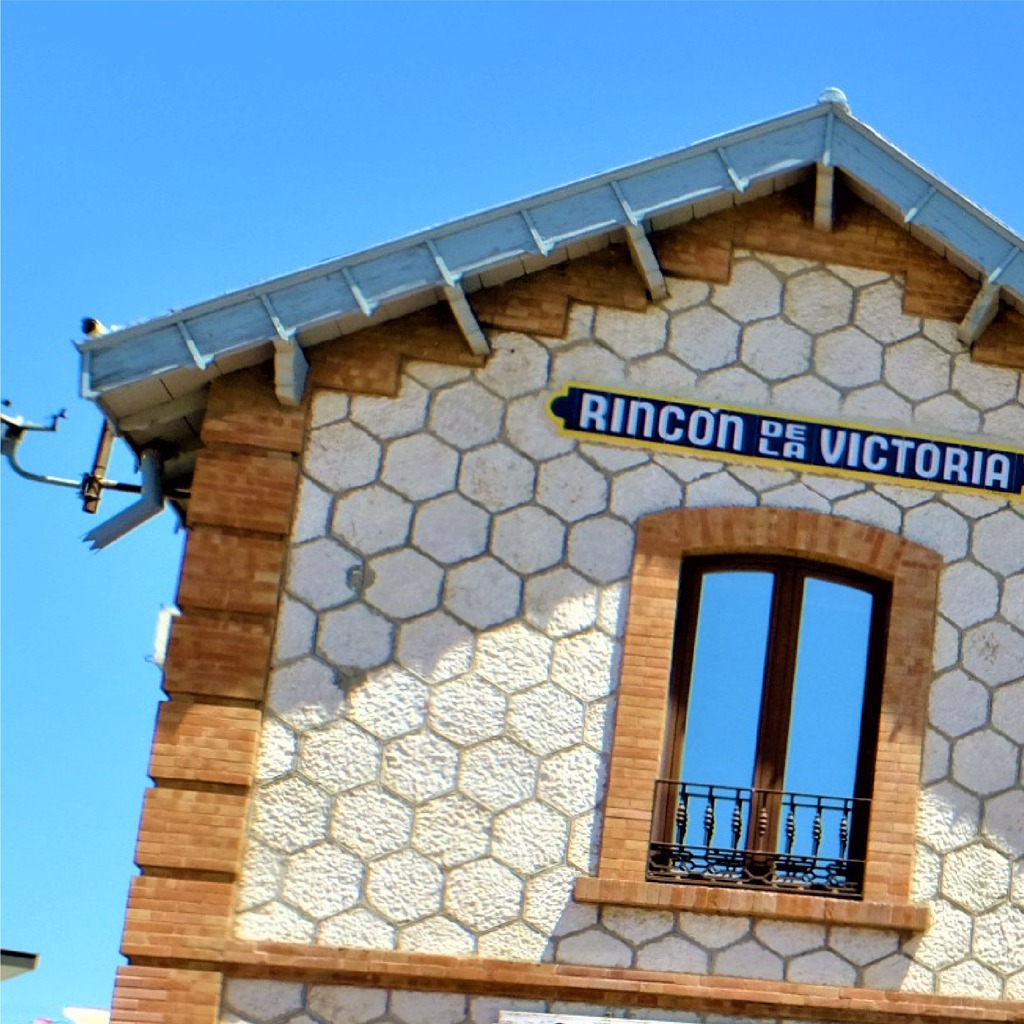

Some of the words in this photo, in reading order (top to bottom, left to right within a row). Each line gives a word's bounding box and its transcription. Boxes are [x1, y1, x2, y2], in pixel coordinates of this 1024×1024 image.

[760, 419, 807, 442] DE
[759, 437, 806, 460] LA
[820, 428, 1010, 489] VICTORIA
